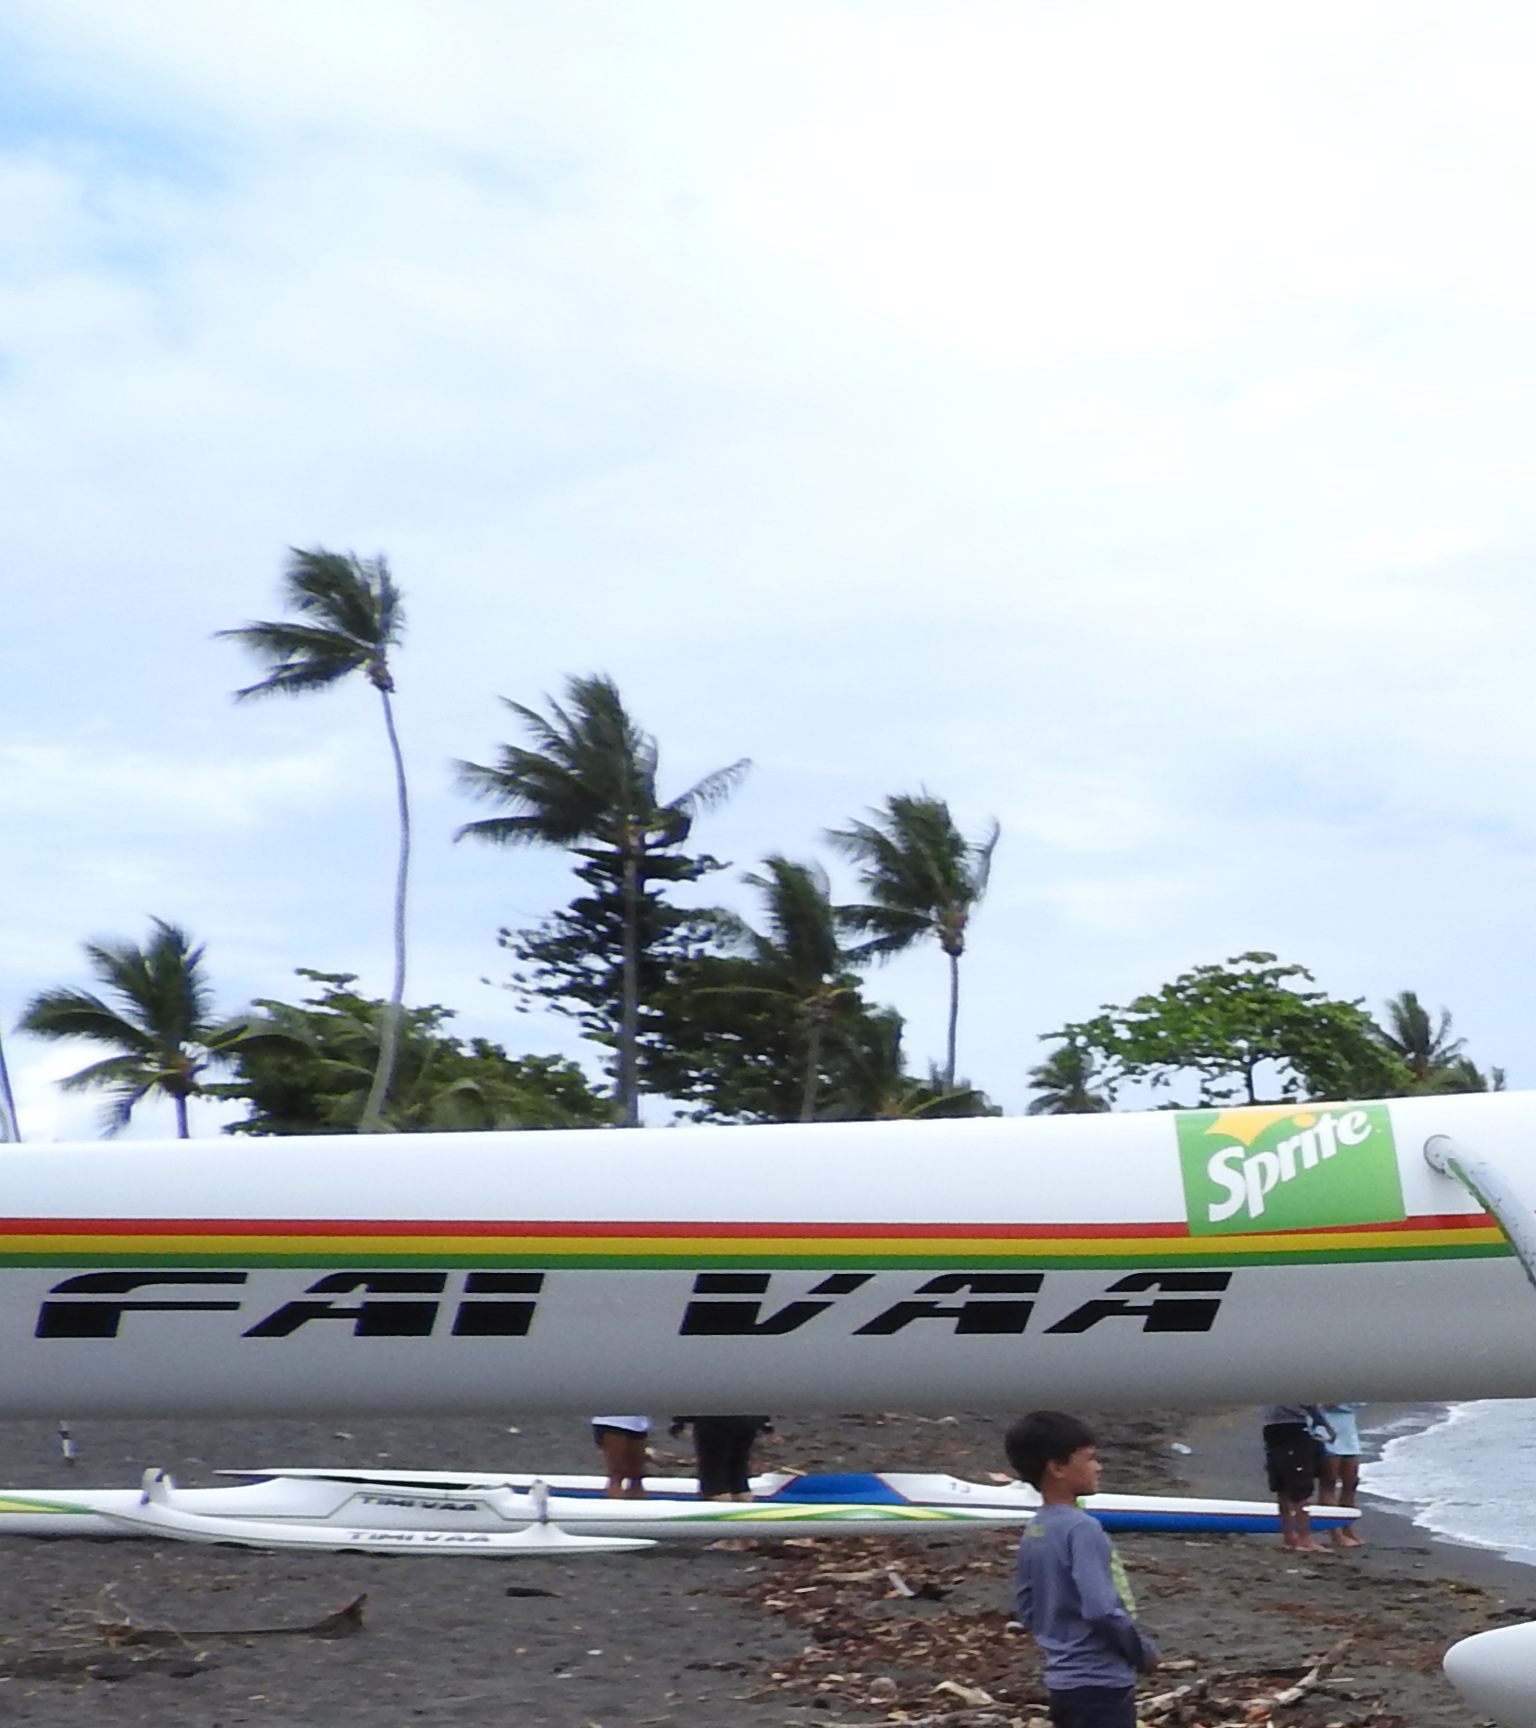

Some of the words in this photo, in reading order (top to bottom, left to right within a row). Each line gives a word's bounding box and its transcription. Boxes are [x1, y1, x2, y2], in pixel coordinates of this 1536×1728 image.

[1207, 1110, 1372, 1222] Sprite
[36, 1271, 544, 1339] FAI
[678, 1271, 1233, 1335] VAA
